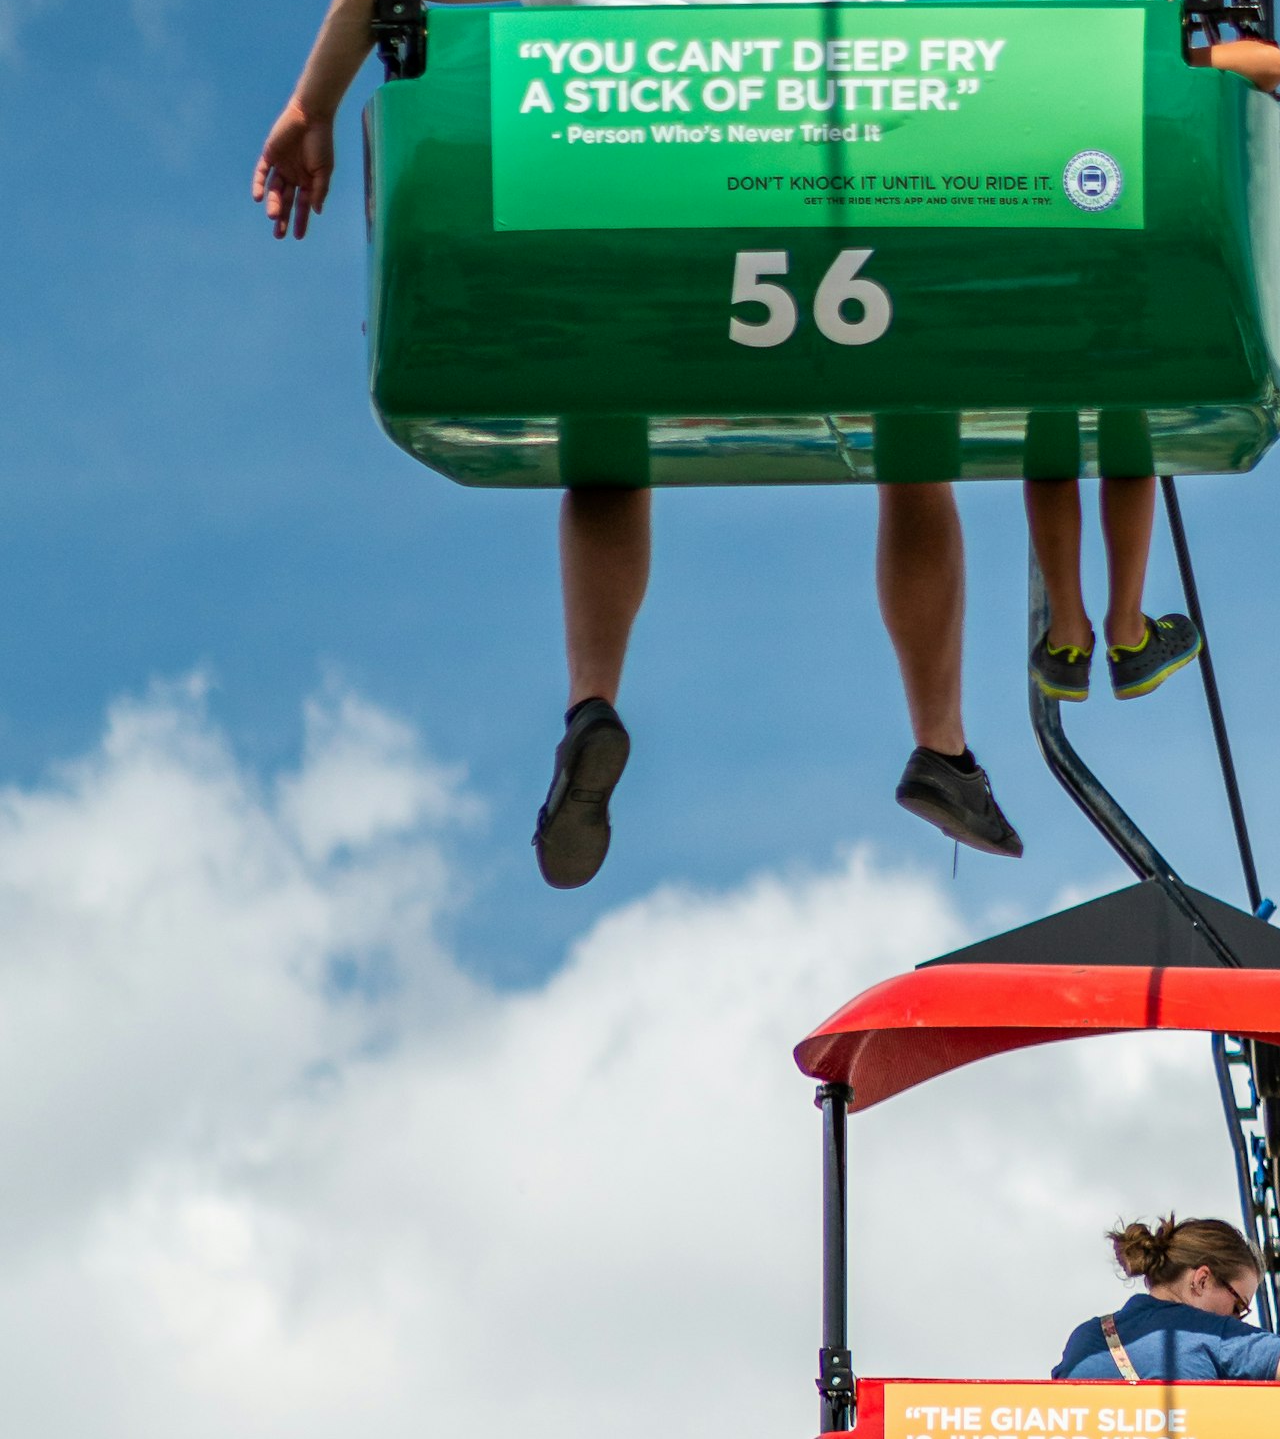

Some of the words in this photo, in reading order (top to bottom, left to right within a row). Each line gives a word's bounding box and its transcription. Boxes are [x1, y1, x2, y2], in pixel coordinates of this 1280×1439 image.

[519, 42, 633, 73] “YOU
[647, 41, 780, 72] CAN’T
[793, 40, 907, 72] DEEP
[920, 40, 1005, 71] FRY
[520, 80, 553, 113] A
[564, 79, 687, 113] STICK
[701, 78, 766, 112] OF
[778, 77, 980, 111] BUTTER.”
[567, 125, 644, 144] Person
[650, 124, 721, 143] Who’s
[728, 124, 793, 142] Never
[800, 123, 857, 142] Tried
[864, 123, 881, 141] It
[727, 177, 784, 191] DON’T
[790, 177, 856, 191] KNOCK
[861, 177, 876, 191] IT
[883, 176, 936, 191] UNTIL
[940, 176, 980, 191] YOU
[986, 176, 1028, 191] RIDE
[1033, 176, 1053, 191] IT.
[804, 196, 822, 206] GET
[826, 196, 845, 206] THE
[849, 196, 872, 206] RIDE
[875, 196, 901, 206] MCTS
[904, 196, 923, 206] APP
[926, 196, 947, 206] AND
[951, 197, 974, 206] GIVE
[977, 197, 996, 206] THE
[1000, 197, 1018, 206] BUS
[1021, 197, 1028, 206] A
[1032, 197, 1052, 206] TRY.
[728, 248, 894, 349] 56
[905, 1407, 981, 1432] “THE
[991, 1407, 1087, 1432] GIANT
[1097, 1408, 1187, 1433] SLIDE
